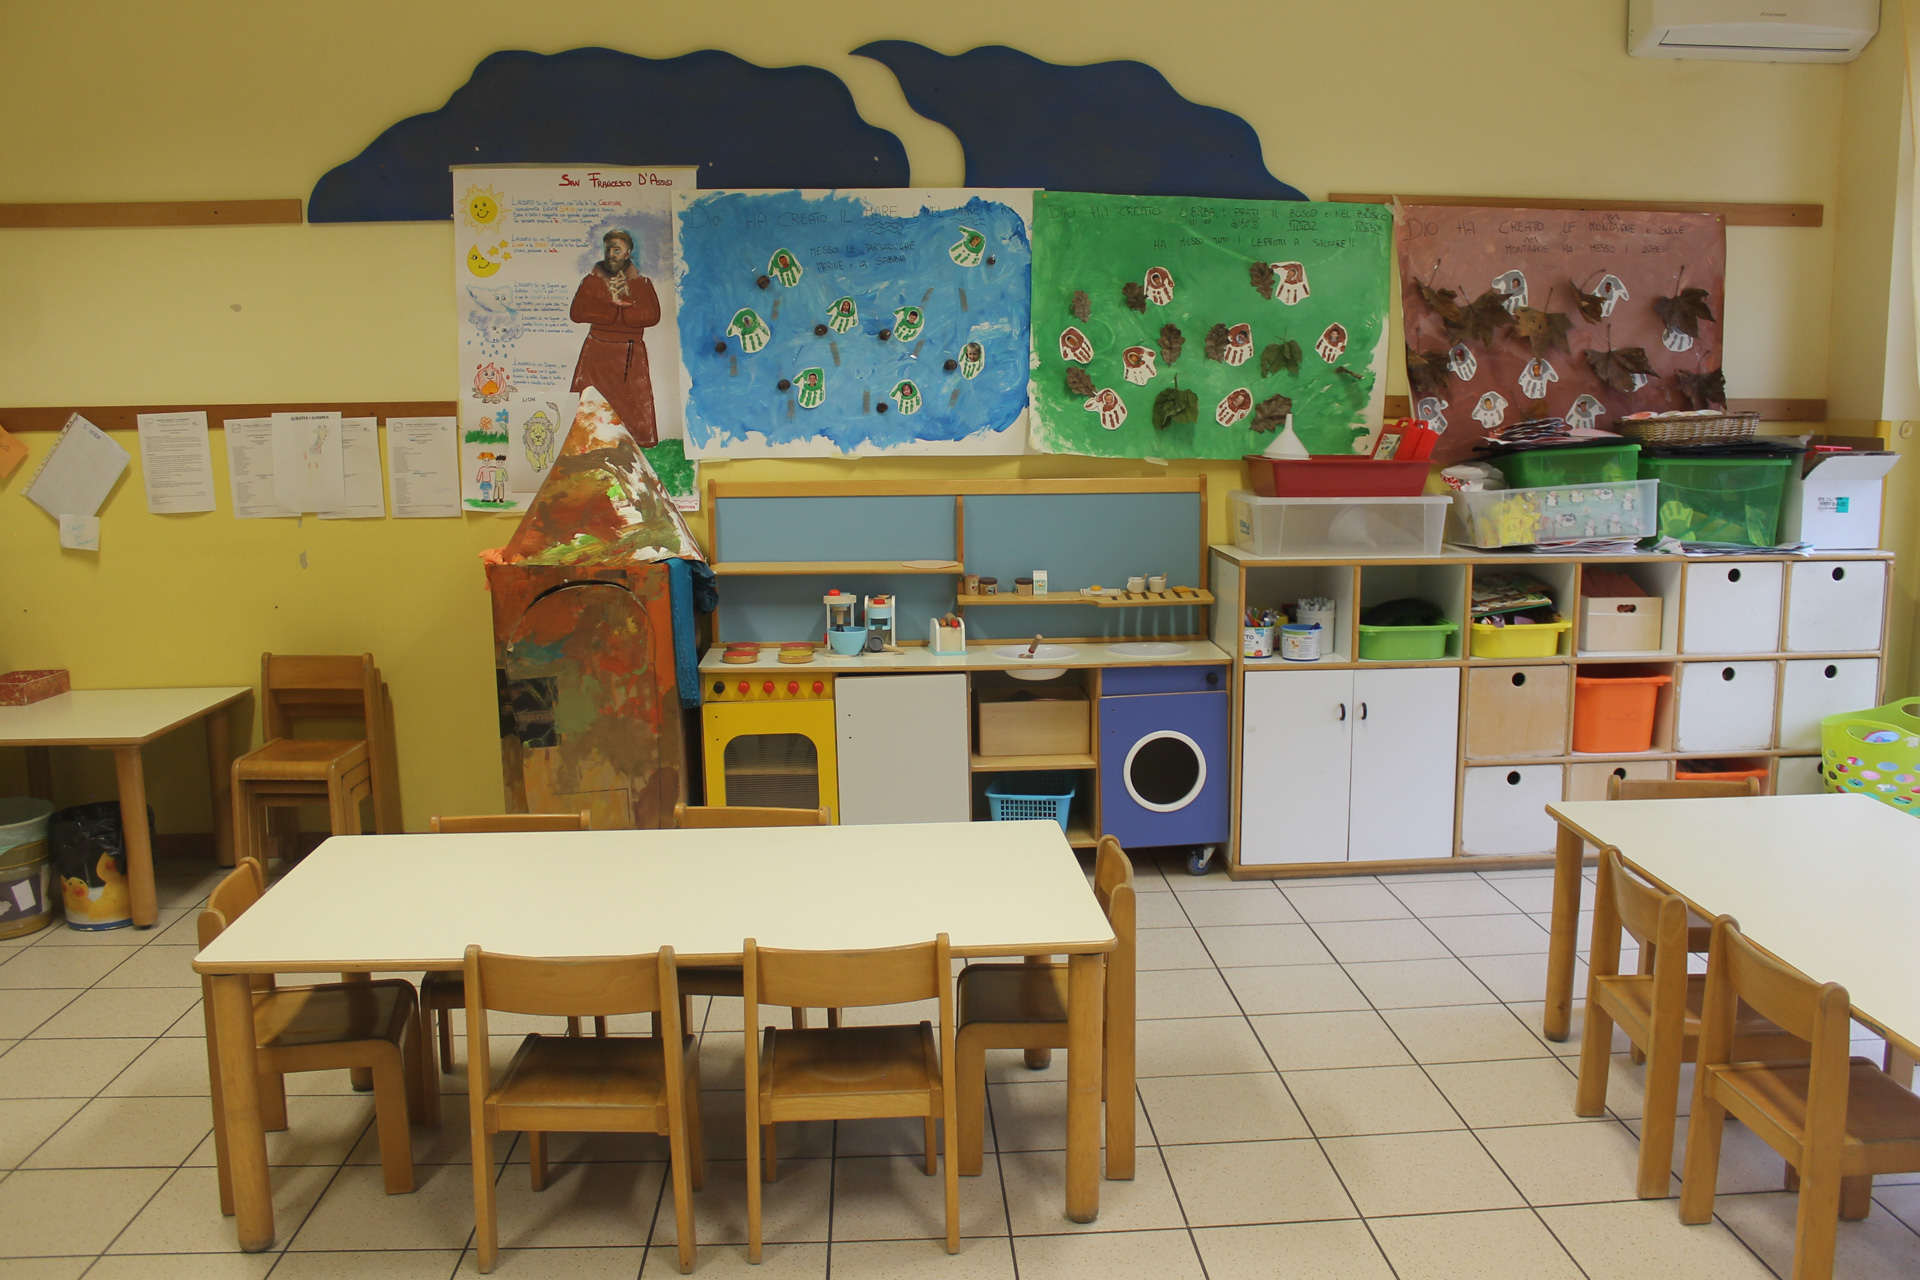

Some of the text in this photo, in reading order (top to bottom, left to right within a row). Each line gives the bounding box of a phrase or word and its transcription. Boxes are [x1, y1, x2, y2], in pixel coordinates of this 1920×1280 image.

[746, 212, 769, 229] HA
[778, 211, 828, 228] CREATO
[865, 204, 899, 219] MARE
[1048, 204, 1076, 219] DIO
[1092, 205, 1109, 219] HA
[1119, 205, 1161, 217] CREATO
[1289, 208, 1318, 219] BOSCO
[1336, 209, 1351, 219] NEL
[1402, 218, 1439, 242] DIO
[1457, 220, 1476, 236] HA
[1498, 220, 1545, 235] CREATO
[1562, 221, 1577, 234] LE
[810, 246, 839, 256] MESSO
[846, 244, 857, 254] LE
[1153, 239, 1166, 251] HA
[1180, 238, 1205, 248] MESSO
[1505, 244, 1549, 256] MONTAGNE
[1562, 244, 1573, 254] HA
[1590, 245, 1616, 254] MESSO
[859, 259, 868, 268] LA
